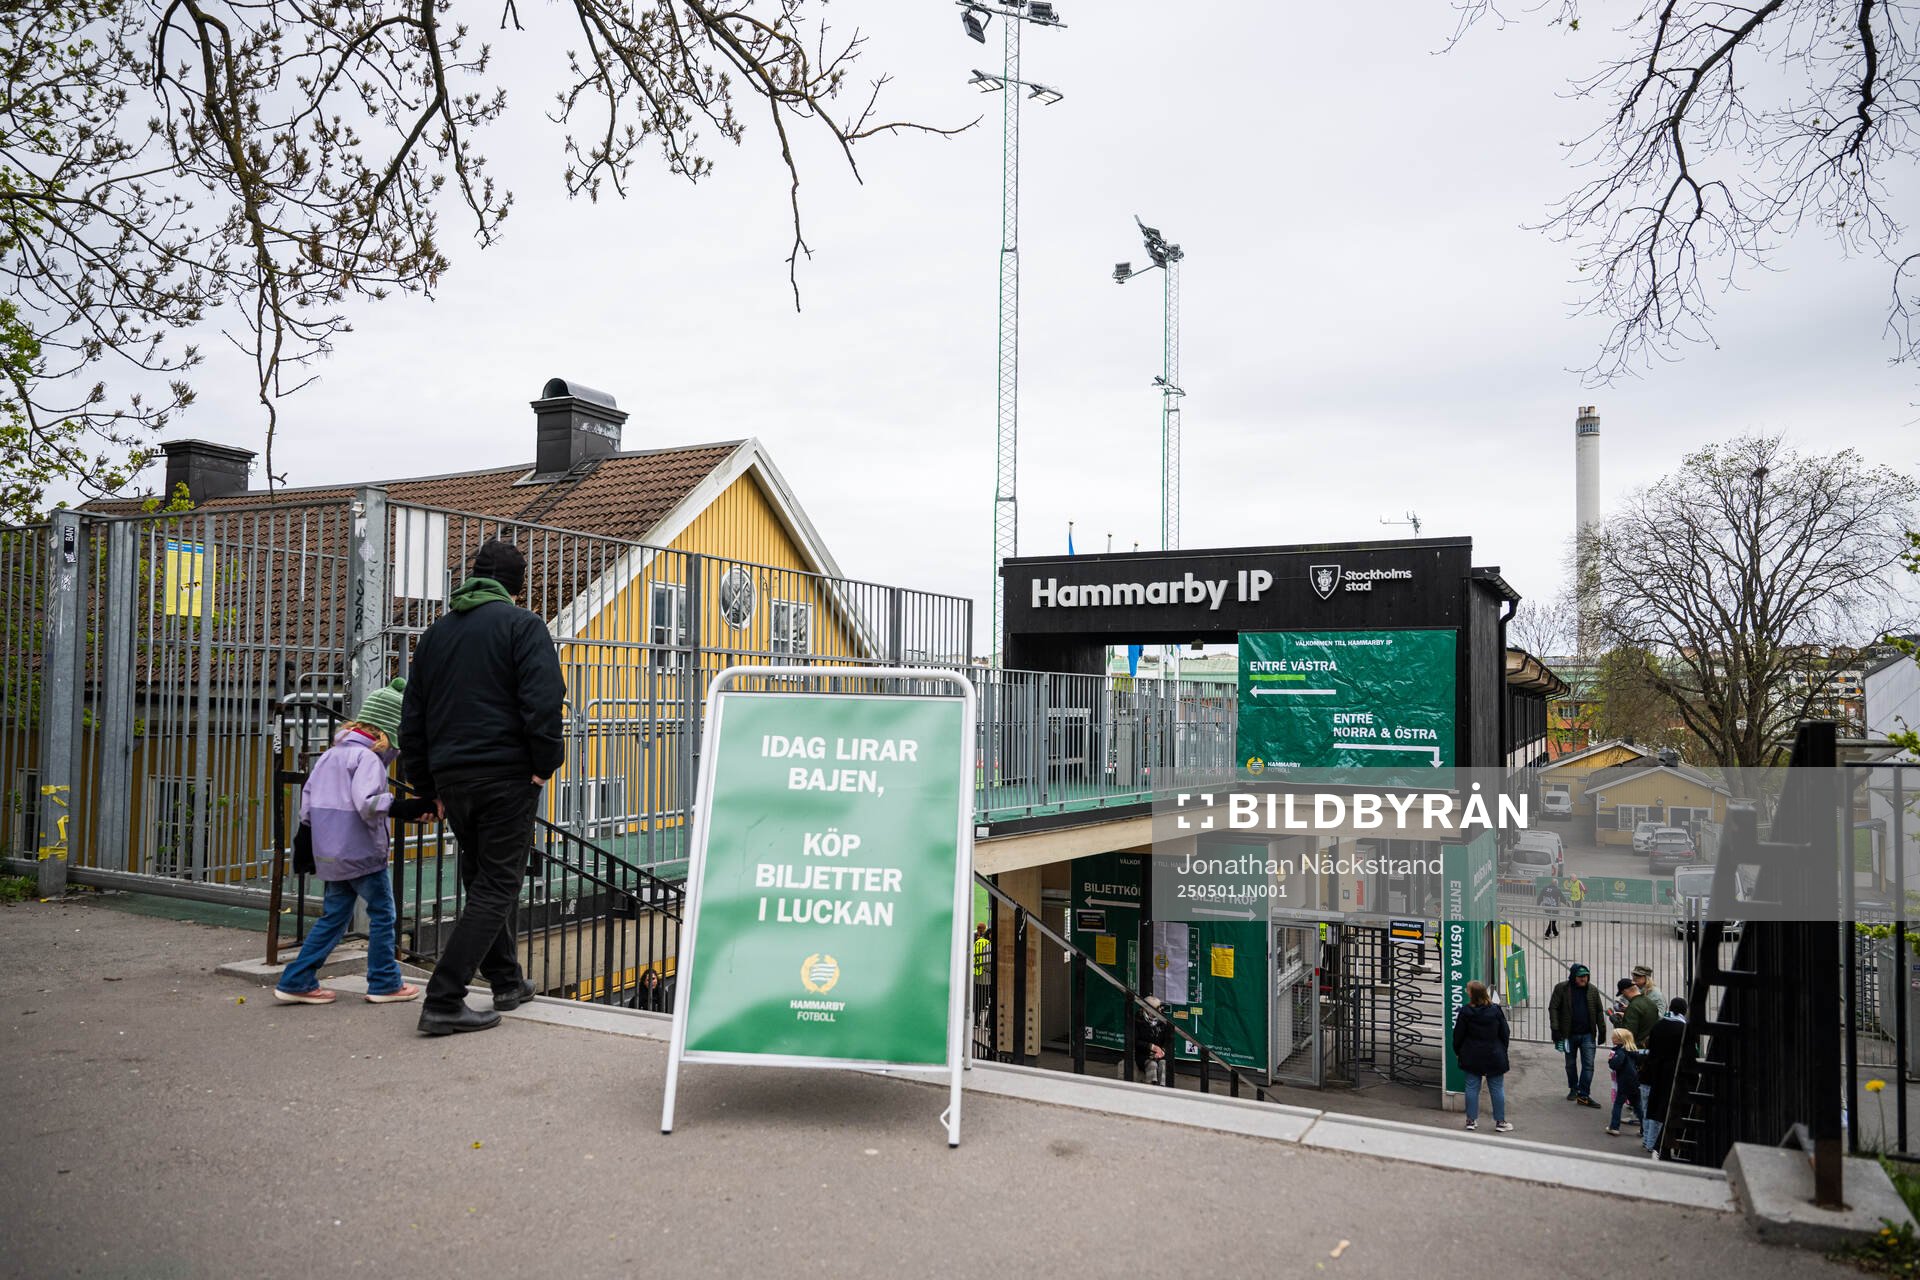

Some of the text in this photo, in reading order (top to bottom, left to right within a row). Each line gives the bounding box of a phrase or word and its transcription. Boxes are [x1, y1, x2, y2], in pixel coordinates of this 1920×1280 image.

[1345, 569, 1412, 580] Stockholms
[1031, 569, 1273, 611] Hammarby IP
[1345, 581, 1372, 591] stad
[1250, 658, 1337, 671] ENTRÉ VÄSTRA
[1333, 711, 1373, 724] ENTRÉ
[1333, 725, 1437, 740] NORRA & ÖSTRA
[761, 735, 918, 762] IDAG LIRAR
[788, 767, 885, 798] BAJEN,
[803, 828, 860, 858] KÖP
[755, 863, 903, 893] BILJETTER
[1084, 882, 1141, 897] BILJETTKÖ
[1450, 880, 1465, 921] ENTRÉ
[758, 897, 894, 926] I LUCKAN
[1451, 924, 1465, 965] ÖSTRA
[1451, 970, 1463, 981] &
[790, 999, 846, 1011] HAMMARBY
[797, 1010, 836, 1022] FOTBOLL
